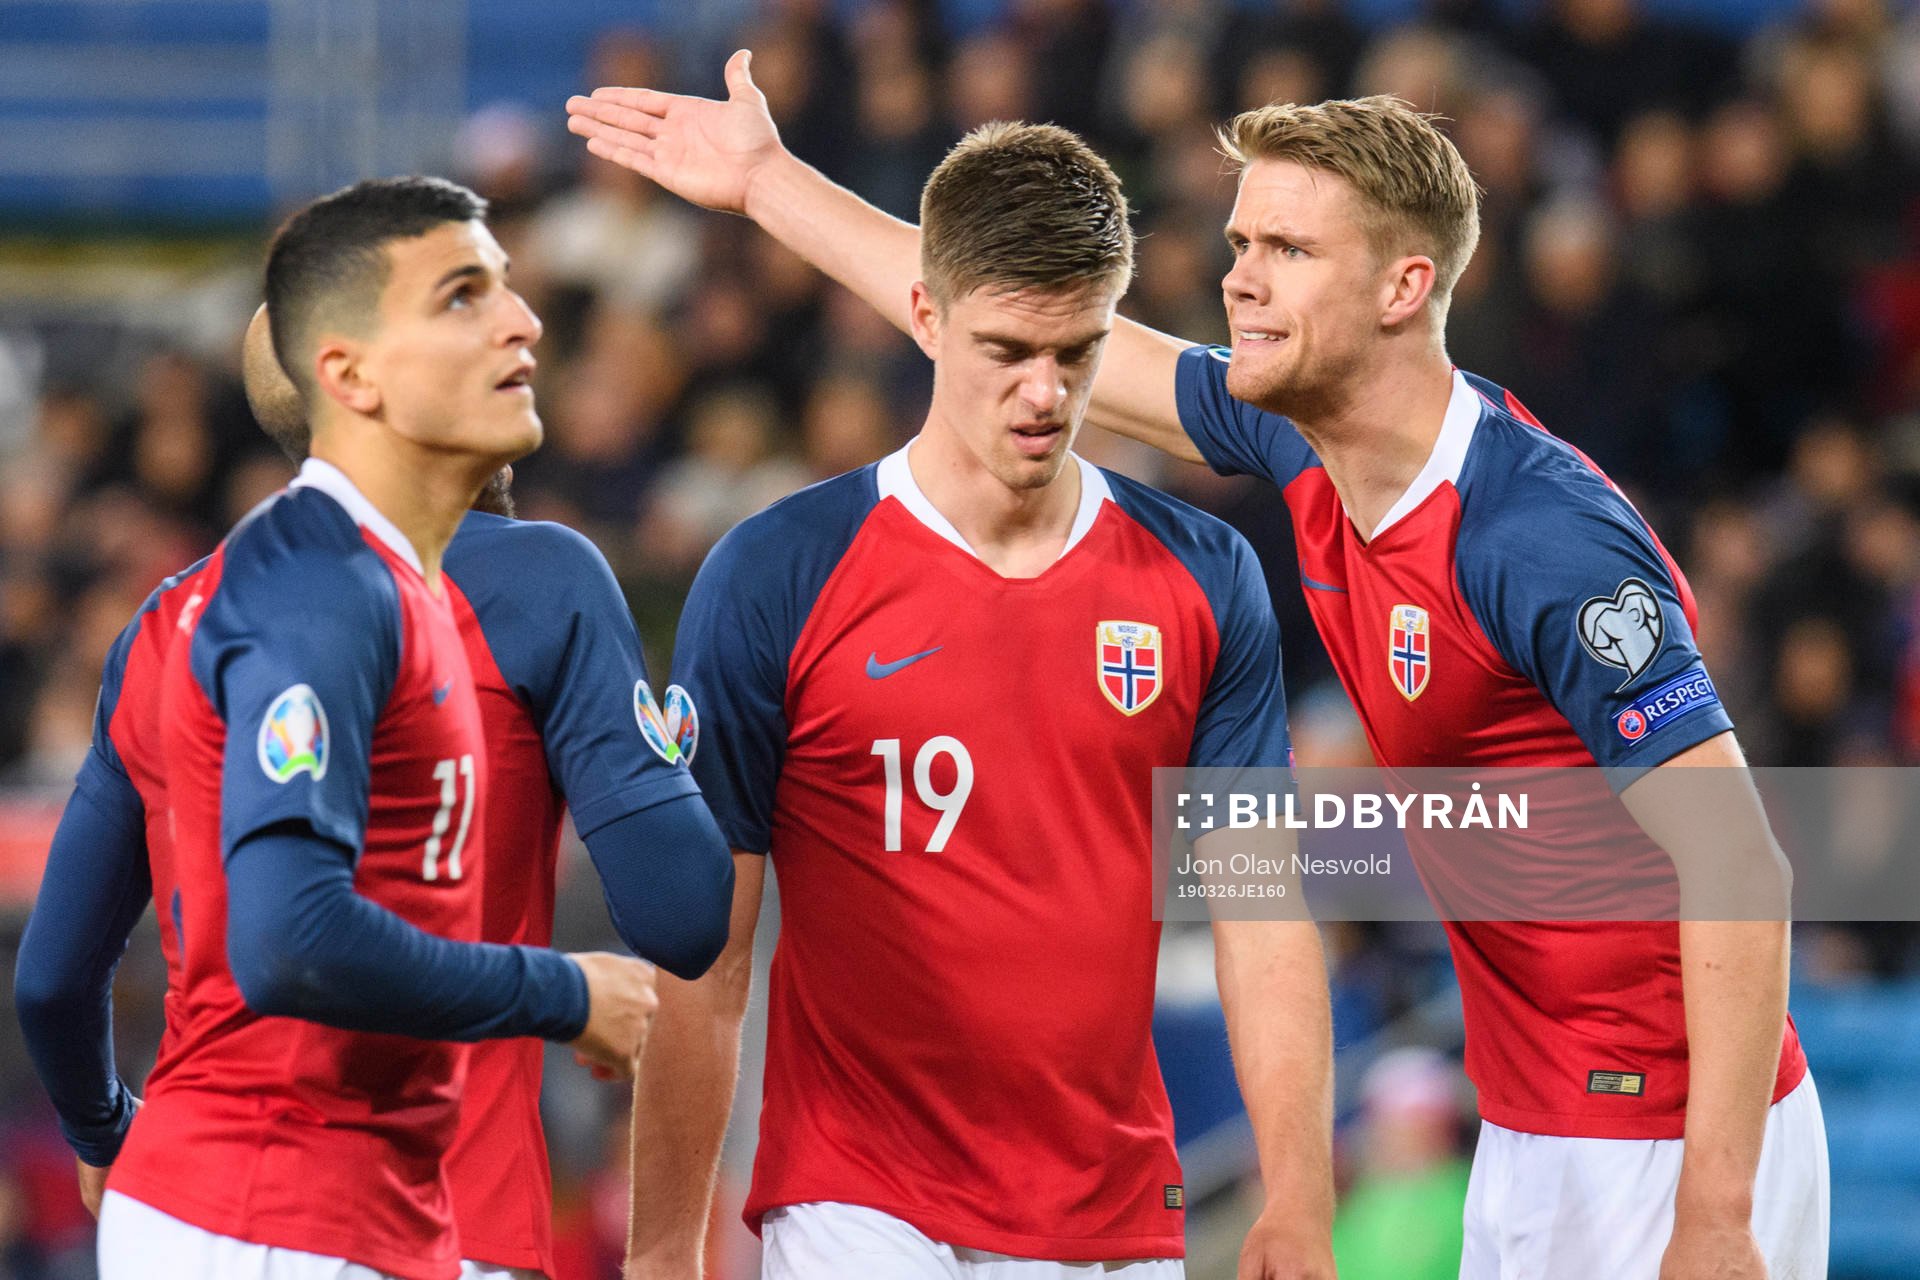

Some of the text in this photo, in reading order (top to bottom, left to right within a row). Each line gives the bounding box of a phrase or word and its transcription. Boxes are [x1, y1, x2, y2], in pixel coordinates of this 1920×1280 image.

[1644, 679, 1712, 722] RESPECT
[423, 754, 475, 880] 11
[871, 736, 974, 853] 19
